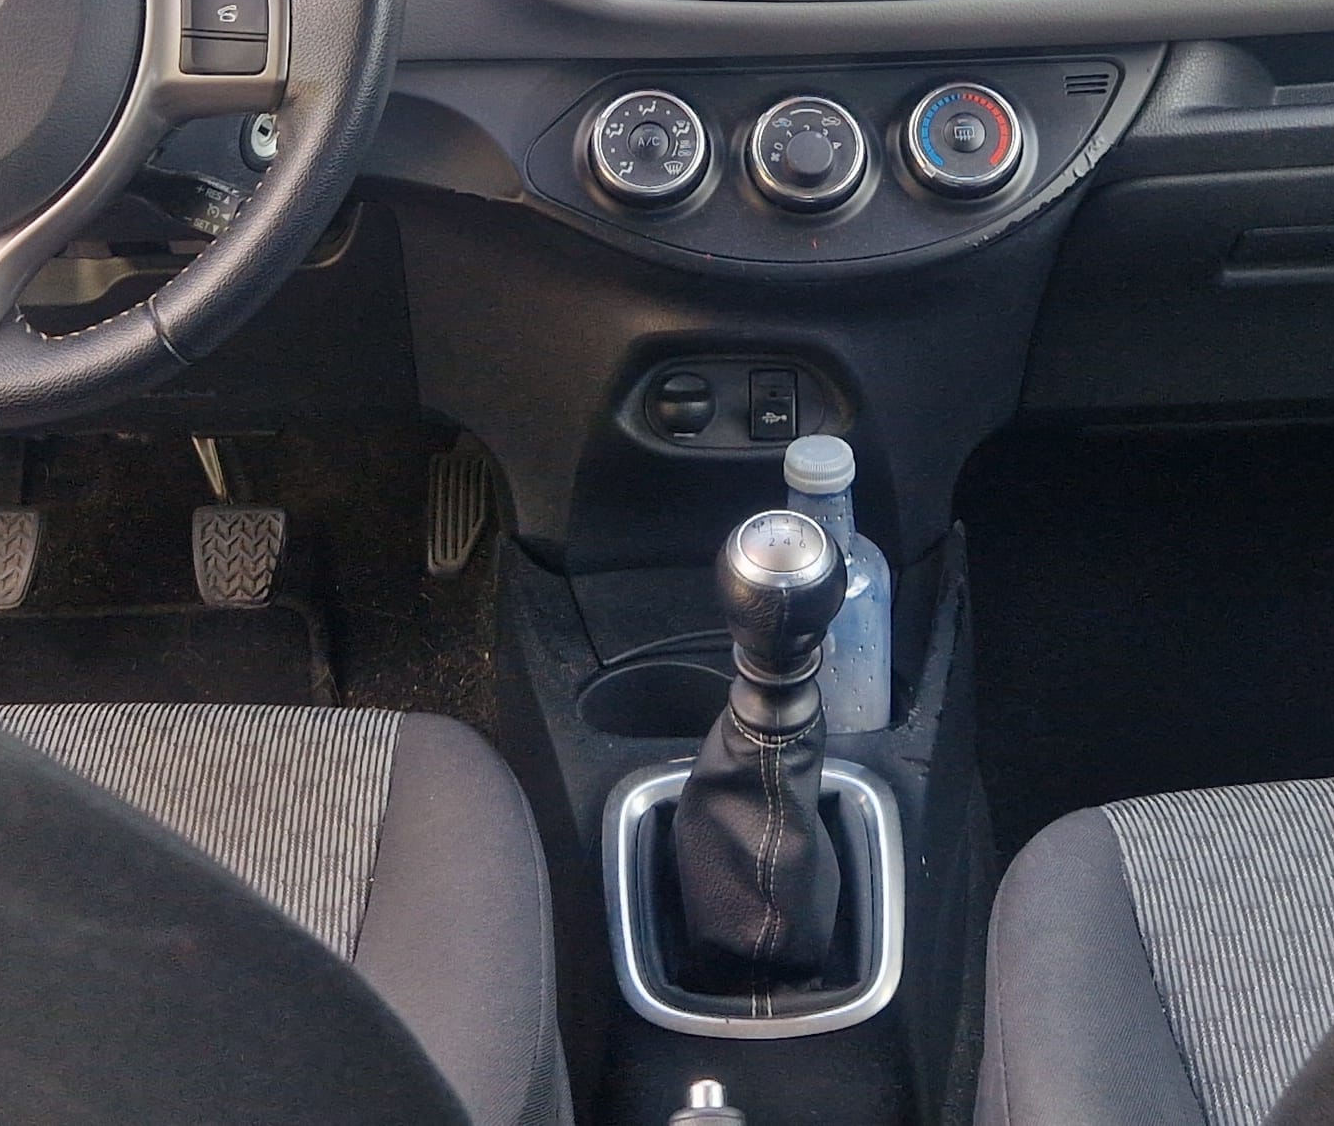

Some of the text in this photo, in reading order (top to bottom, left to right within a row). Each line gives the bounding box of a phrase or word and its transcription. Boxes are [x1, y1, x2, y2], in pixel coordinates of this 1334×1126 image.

[637, 136, 660, 147] A/C
[769, 537, 806, 549] 2 4 6
